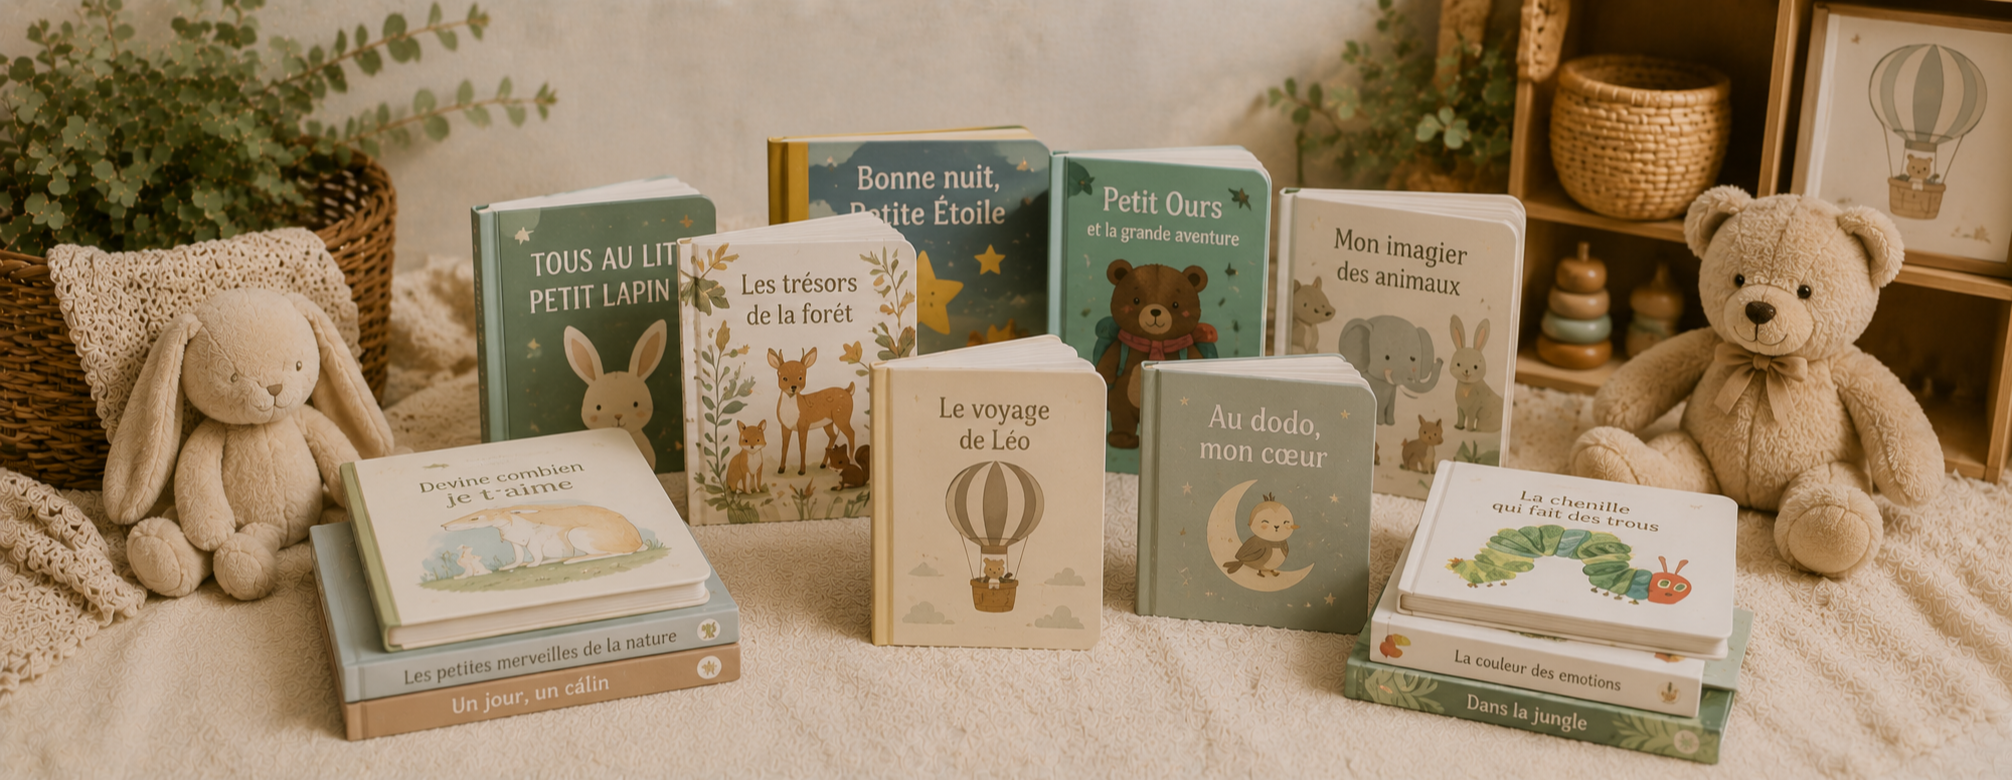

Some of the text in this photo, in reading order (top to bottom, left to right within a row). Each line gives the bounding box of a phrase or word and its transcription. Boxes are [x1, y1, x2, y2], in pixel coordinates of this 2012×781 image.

[857, 164, 1000, 193] Bonne nuit,
[934, 194, 1006, 225] Étoile
[1103, 186, 1223, 219] Petit Ours
[1087, 221, 1240, 247] et la grande aventure
[1334, 227, 1468, 268] Mon imagier
[530, 241, 677, 277] TOUS AU LIT
[741, 271, 858, 295] Les trésors
[1337, 260, 1461, 297] des animaux
[529, 278, 670, 314] PETIT LAPIN
[746, 304, 771, 326] de
[777, 303, 796, 325] la
[939, 396, 1050, 427] Le voyage
[1208, 403, 1321, 441] Au dodo,
[959, 428, 1030, 451] de Léo
[1199, 441, 1328, 469] mon cœur
[419, 462, 585, 494] Devine combien
[446, 492, 473, 509] je
[1520, 490, 1630, 515] La chenille
[1492, 502, 1660, 533] qui fait des trous
[404, 669, 432, 685] Les
[497, 644, 578, 671] merveilles
[583, 640, 602, 657] de
[606, 637, 621, 653] la
[626, 631, 677, 650] nature
[1454, 649, 1622, 692] La couleur des emotions
[451, 696, 479, 714] Un
[483, 690, 529, 714] jour,
[535, 685, 559, 701] un
[1467, 693, 1588, 733] Dans la jungle
